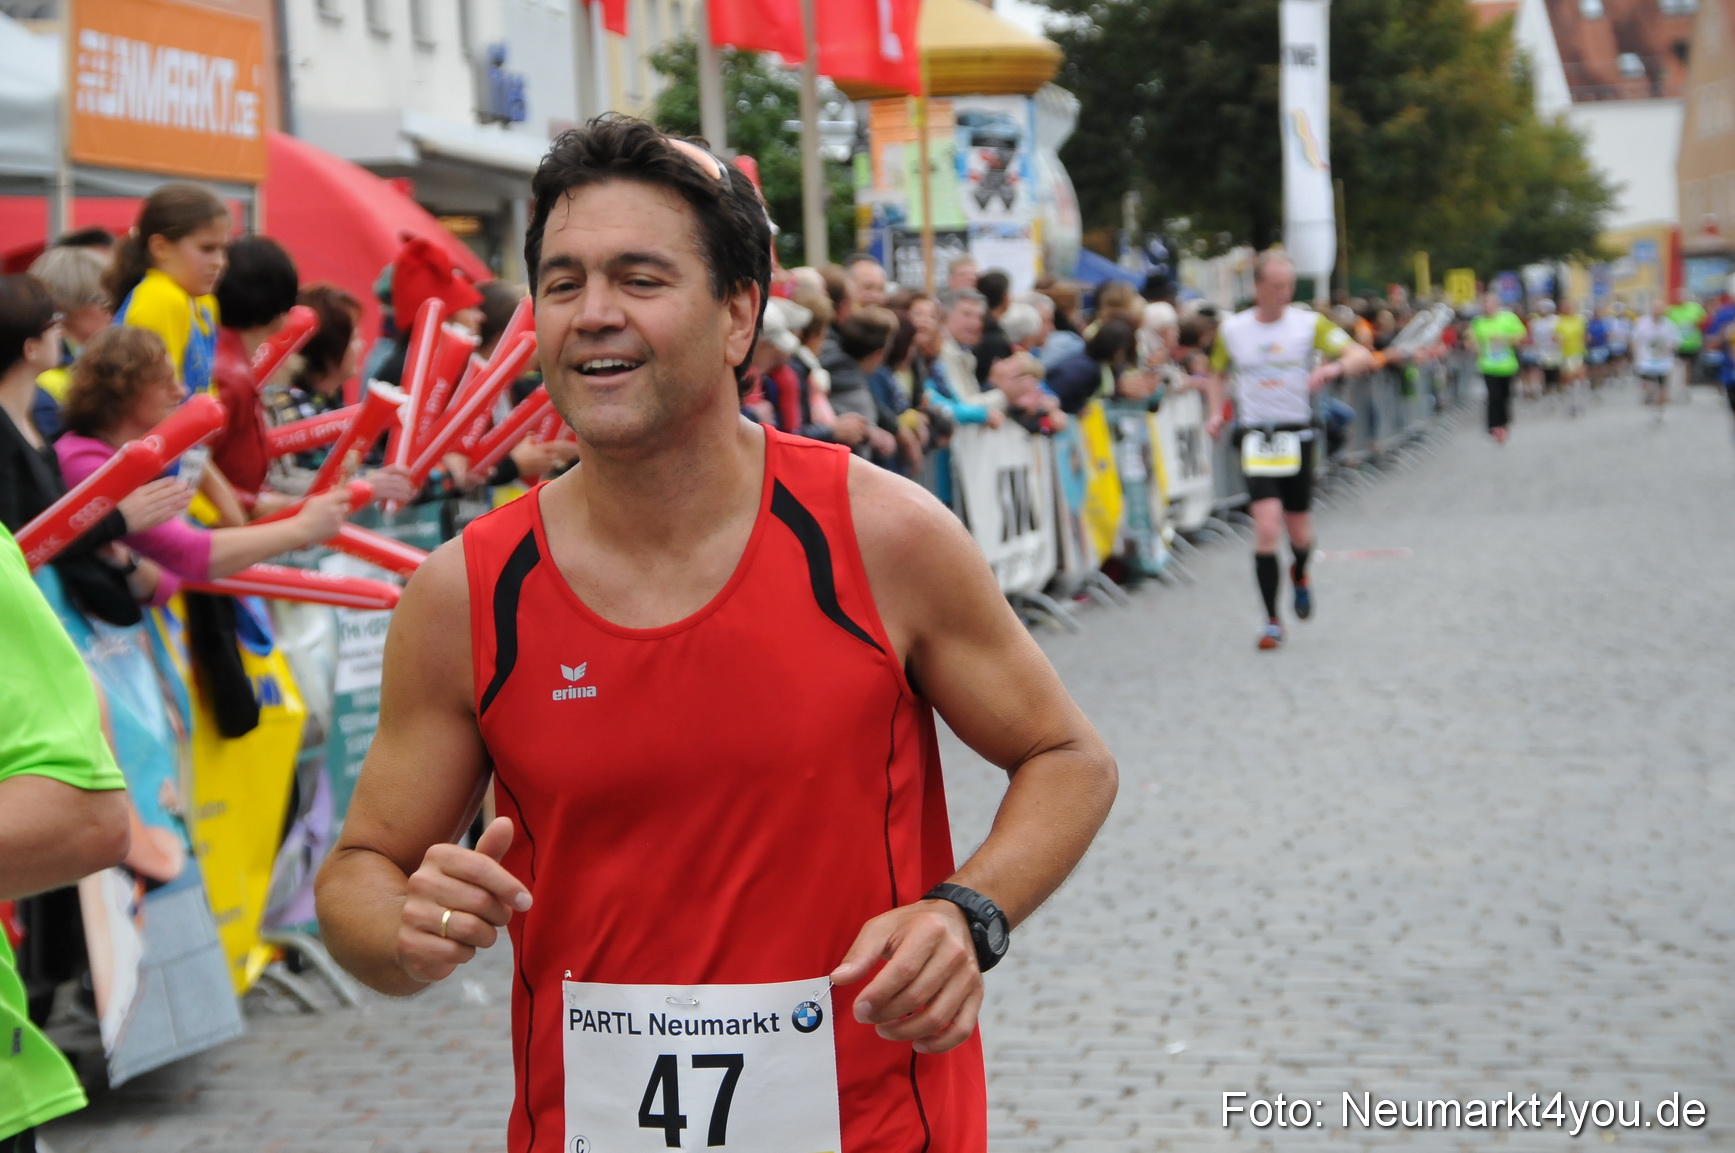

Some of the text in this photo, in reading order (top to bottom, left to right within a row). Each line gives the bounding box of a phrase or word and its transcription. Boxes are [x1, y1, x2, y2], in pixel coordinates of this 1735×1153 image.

[552, 685, 597, 701] erima
[569, 1008, 641, 1035] PARTL
[649, 1012, 780, 1036] Neumarkt
[638, 1054, 744, 1148] 47
